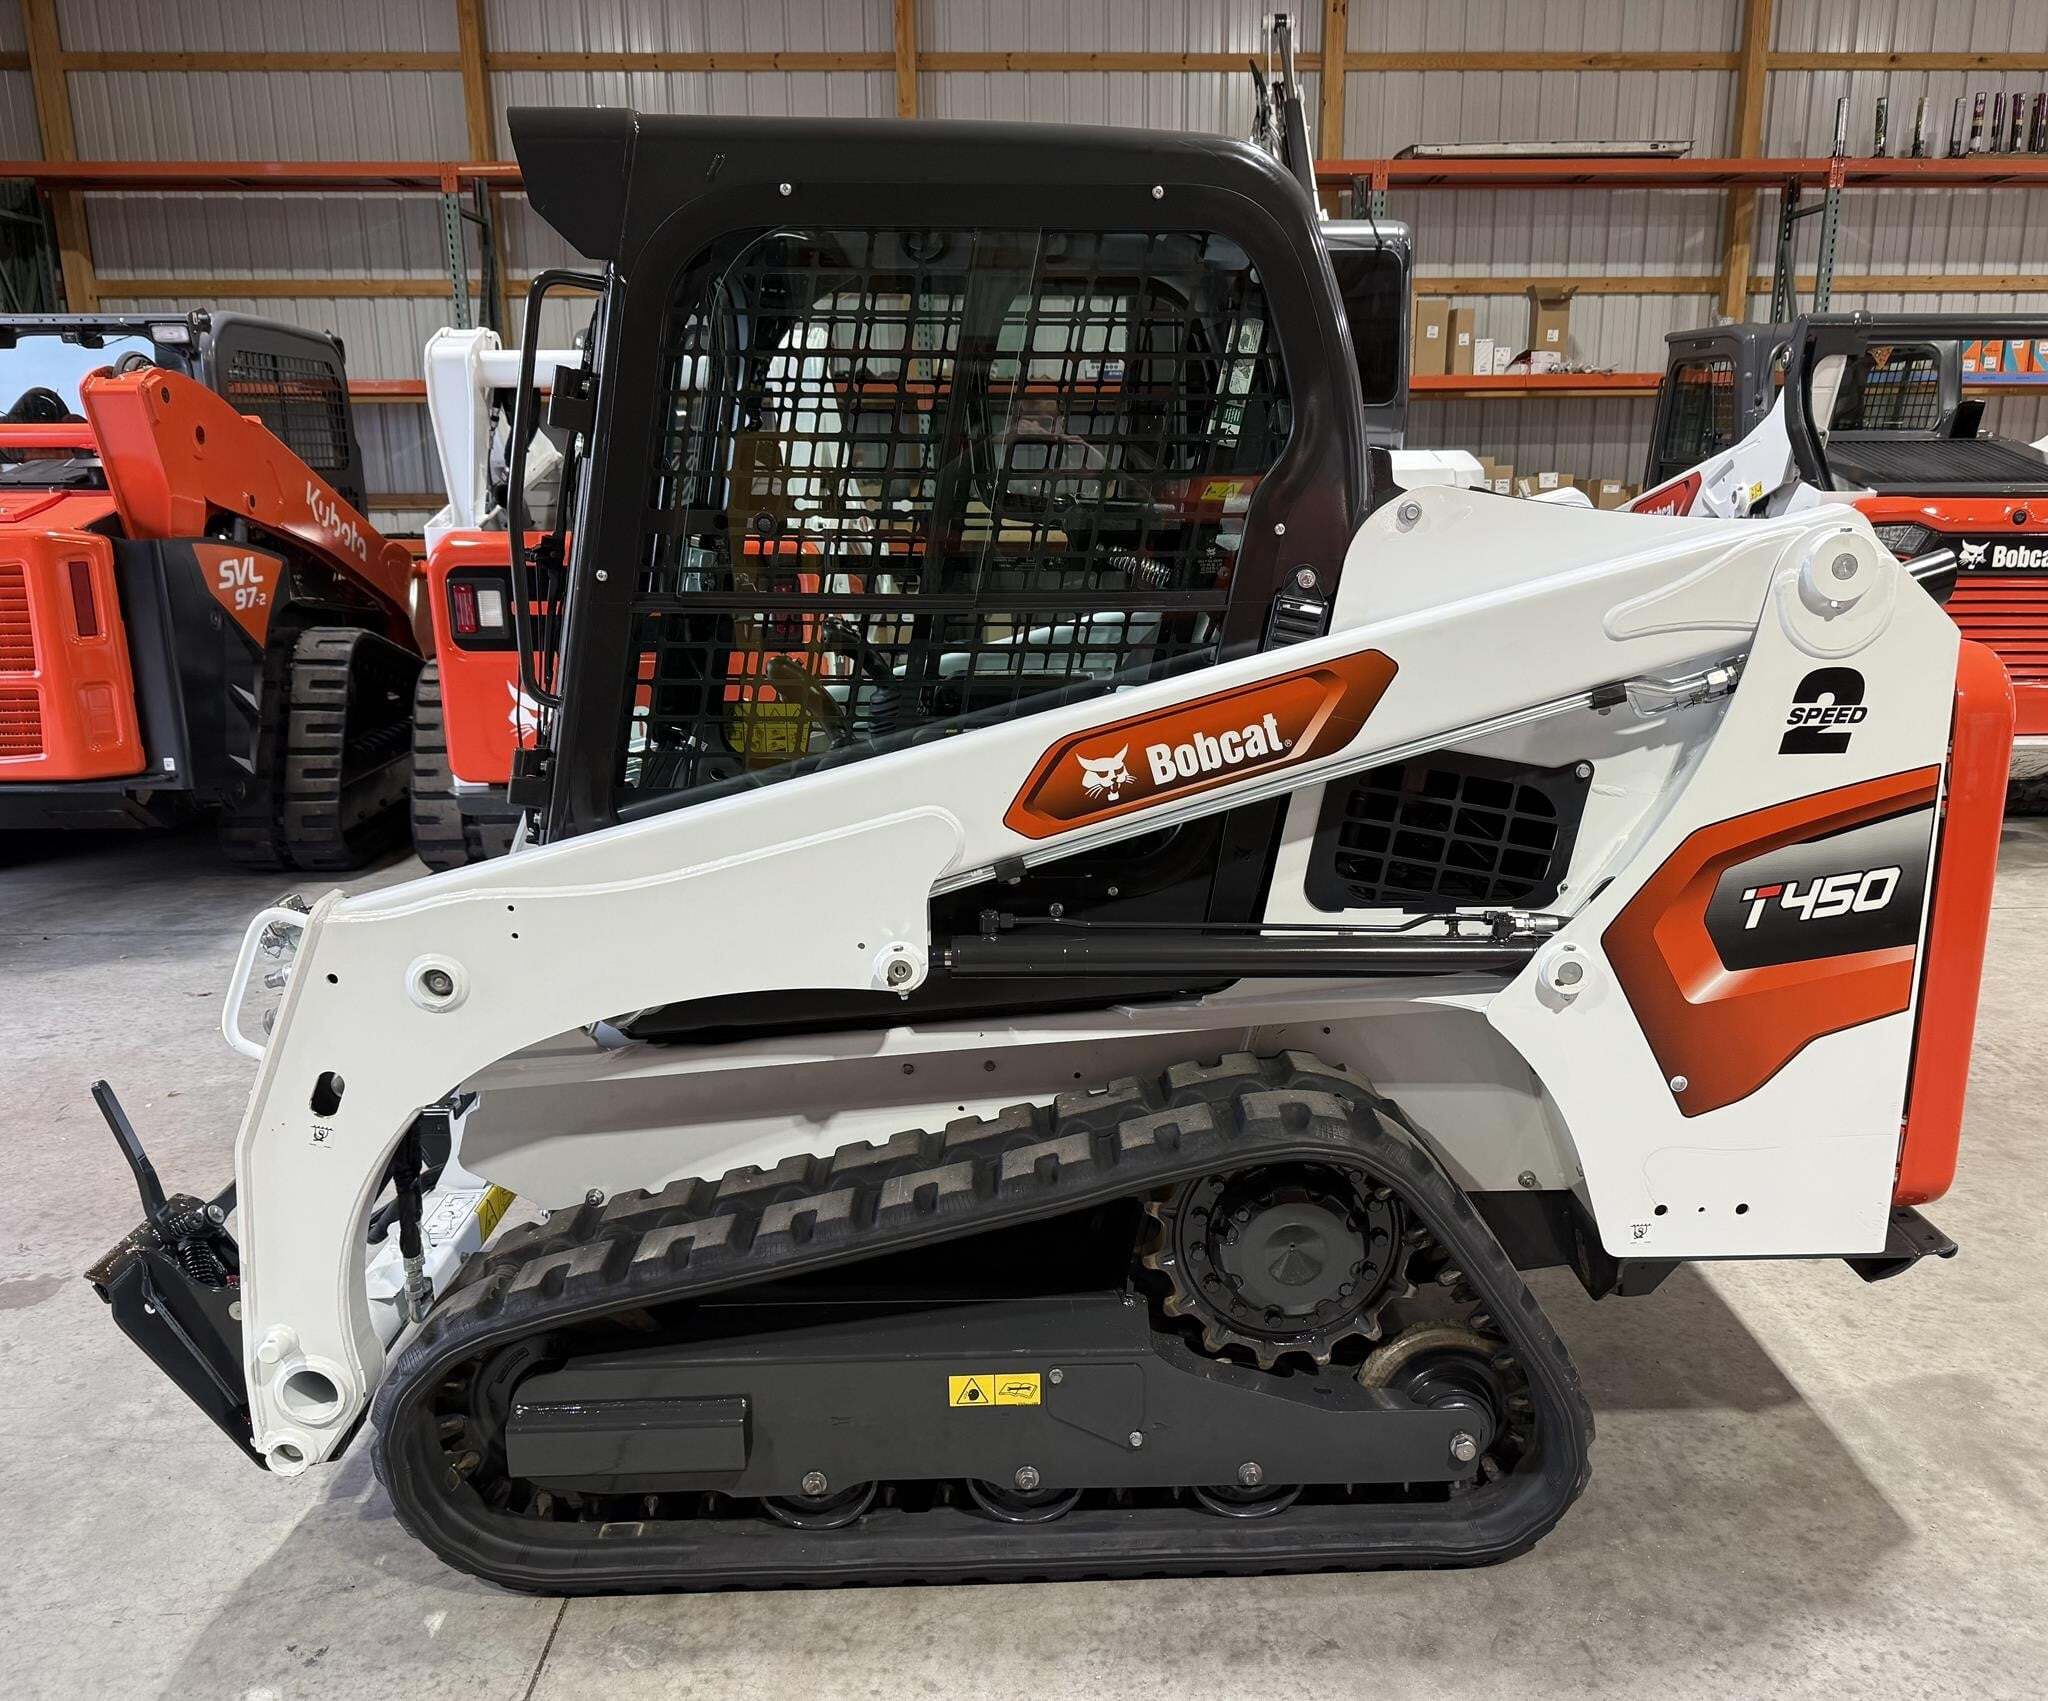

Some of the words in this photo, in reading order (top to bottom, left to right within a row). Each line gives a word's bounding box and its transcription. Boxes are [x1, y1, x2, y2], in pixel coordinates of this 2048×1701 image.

[305, 480, 367, 561] Kubota
[218, 556, 264, 590] SVL
[1778, 666, 1865, 754] 2
[1786, 706, 1868, 726] SPEED
[1145, 713, 1283, 785] Bobcat
[1741, 865, 1903, 930] T450
